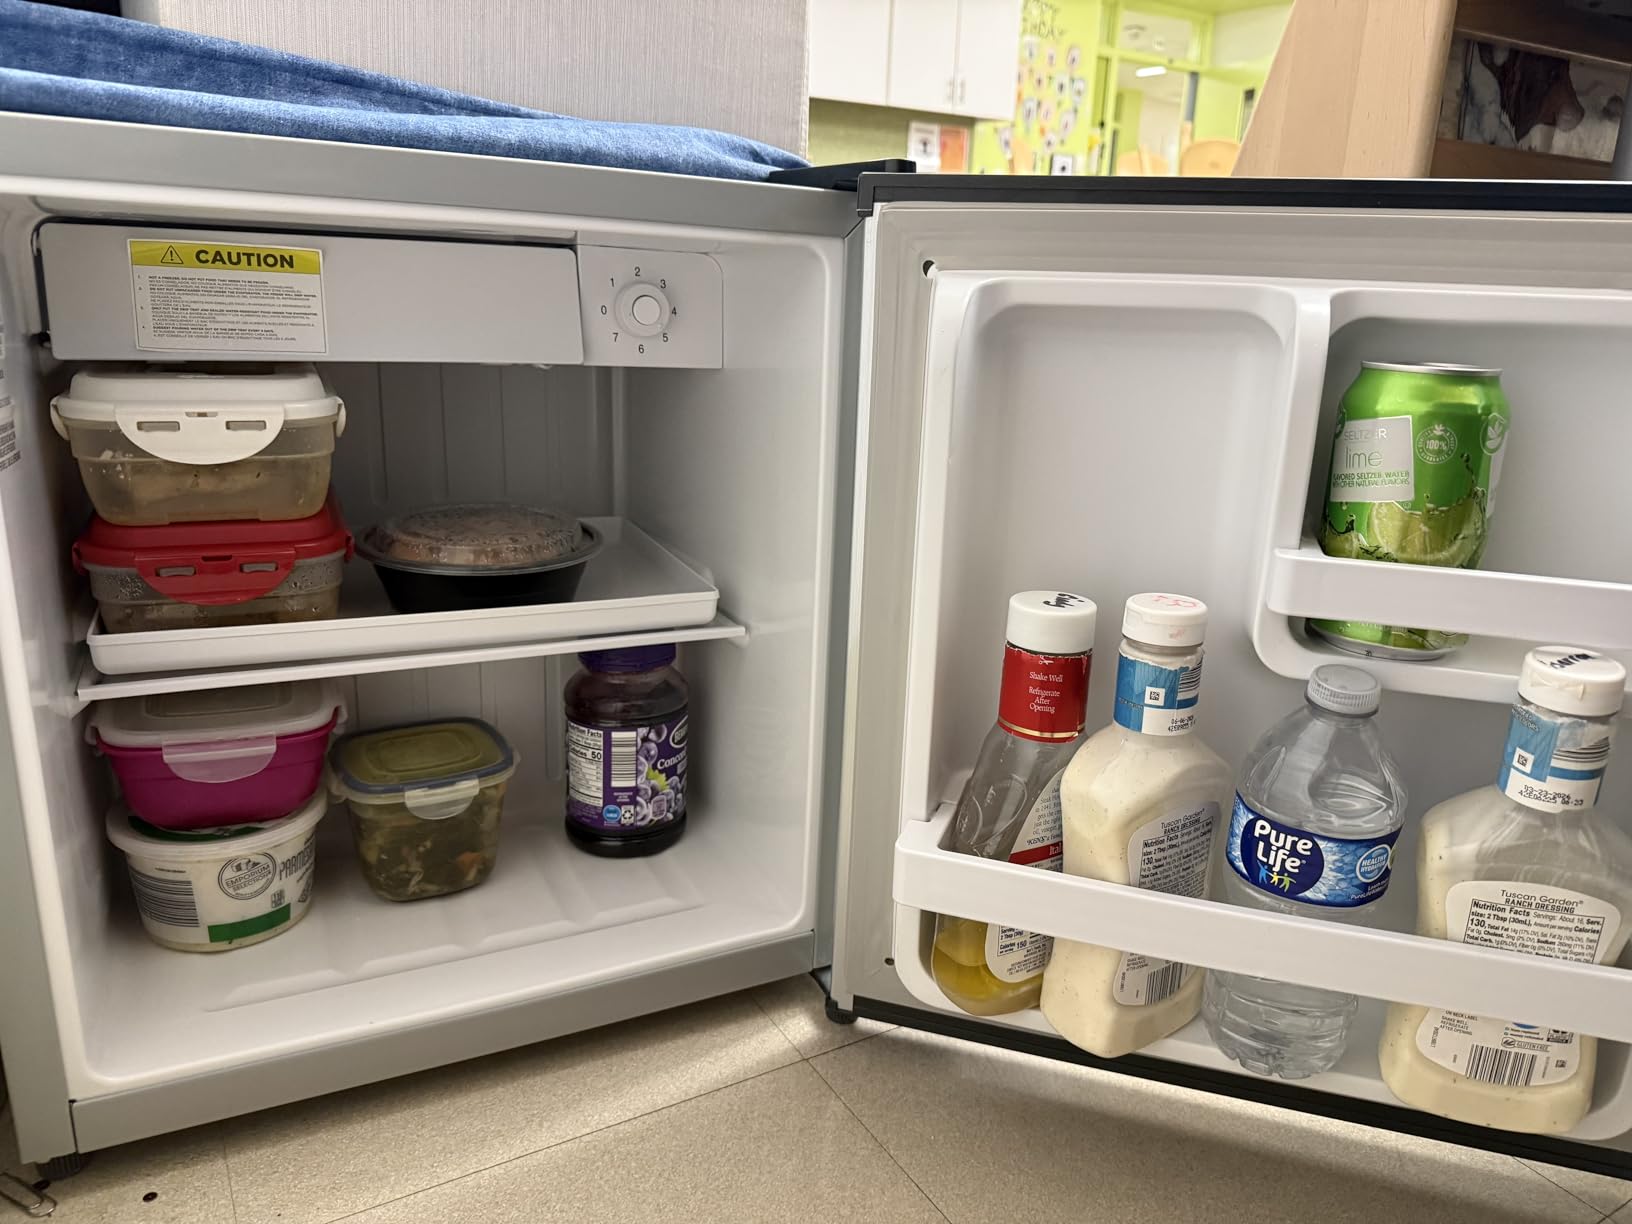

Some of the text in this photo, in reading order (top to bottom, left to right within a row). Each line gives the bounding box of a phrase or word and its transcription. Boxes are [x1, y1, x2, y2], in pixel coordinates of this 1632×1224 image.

[195, 249, 294, 268] CAUTION
[634, 266, 641, 277] 2
[610, 278, 615, 287] 1
[660, 279, 666, 289] 3
[601, 305, 607, 315] 0
[672, 306, 677, 317] 4
[612, 332, 618, 342] 7
[662, 333, 669, 342] 5
[638, 344, 644, 354] 6
[1344, 428, 1387, 440] SELTZR
[1346, 446, 1382, 469] lime
[1030, 672, 1063, 682] Shake Well
[1029, 686, 1060, 698] Refrigerate
[1034, 696, 1050, 705] After
[1030, 703, 1055, 713] Opening
[591, 751, 602, 760] 50
[1161, 818, 1182, 830] Tuscan
[1164, 826, 1179, 834] RANCH
[1144, 838, 1165, 848] Nutrition
[1166, 834, 1179, 842] Facts
[1254, 819, 1313, 856] Pure
[1256, 841, 1300, 874] Life
[1362, 853, 1387, 866] HEALTHY
[226, 864, 270, 888] EMPORIUM
[1501, 890, 1578, 907] Tuscan Garden
[1473, 901, 1506, 913] Nutrition
[1509, 907, 1530, 916] Facts
[1505, 898, 1575, 914] RANCH DRESSING
[1493, 914, 1507, 923] Tbsp
[1574, 926, 1600, 934] Calories
